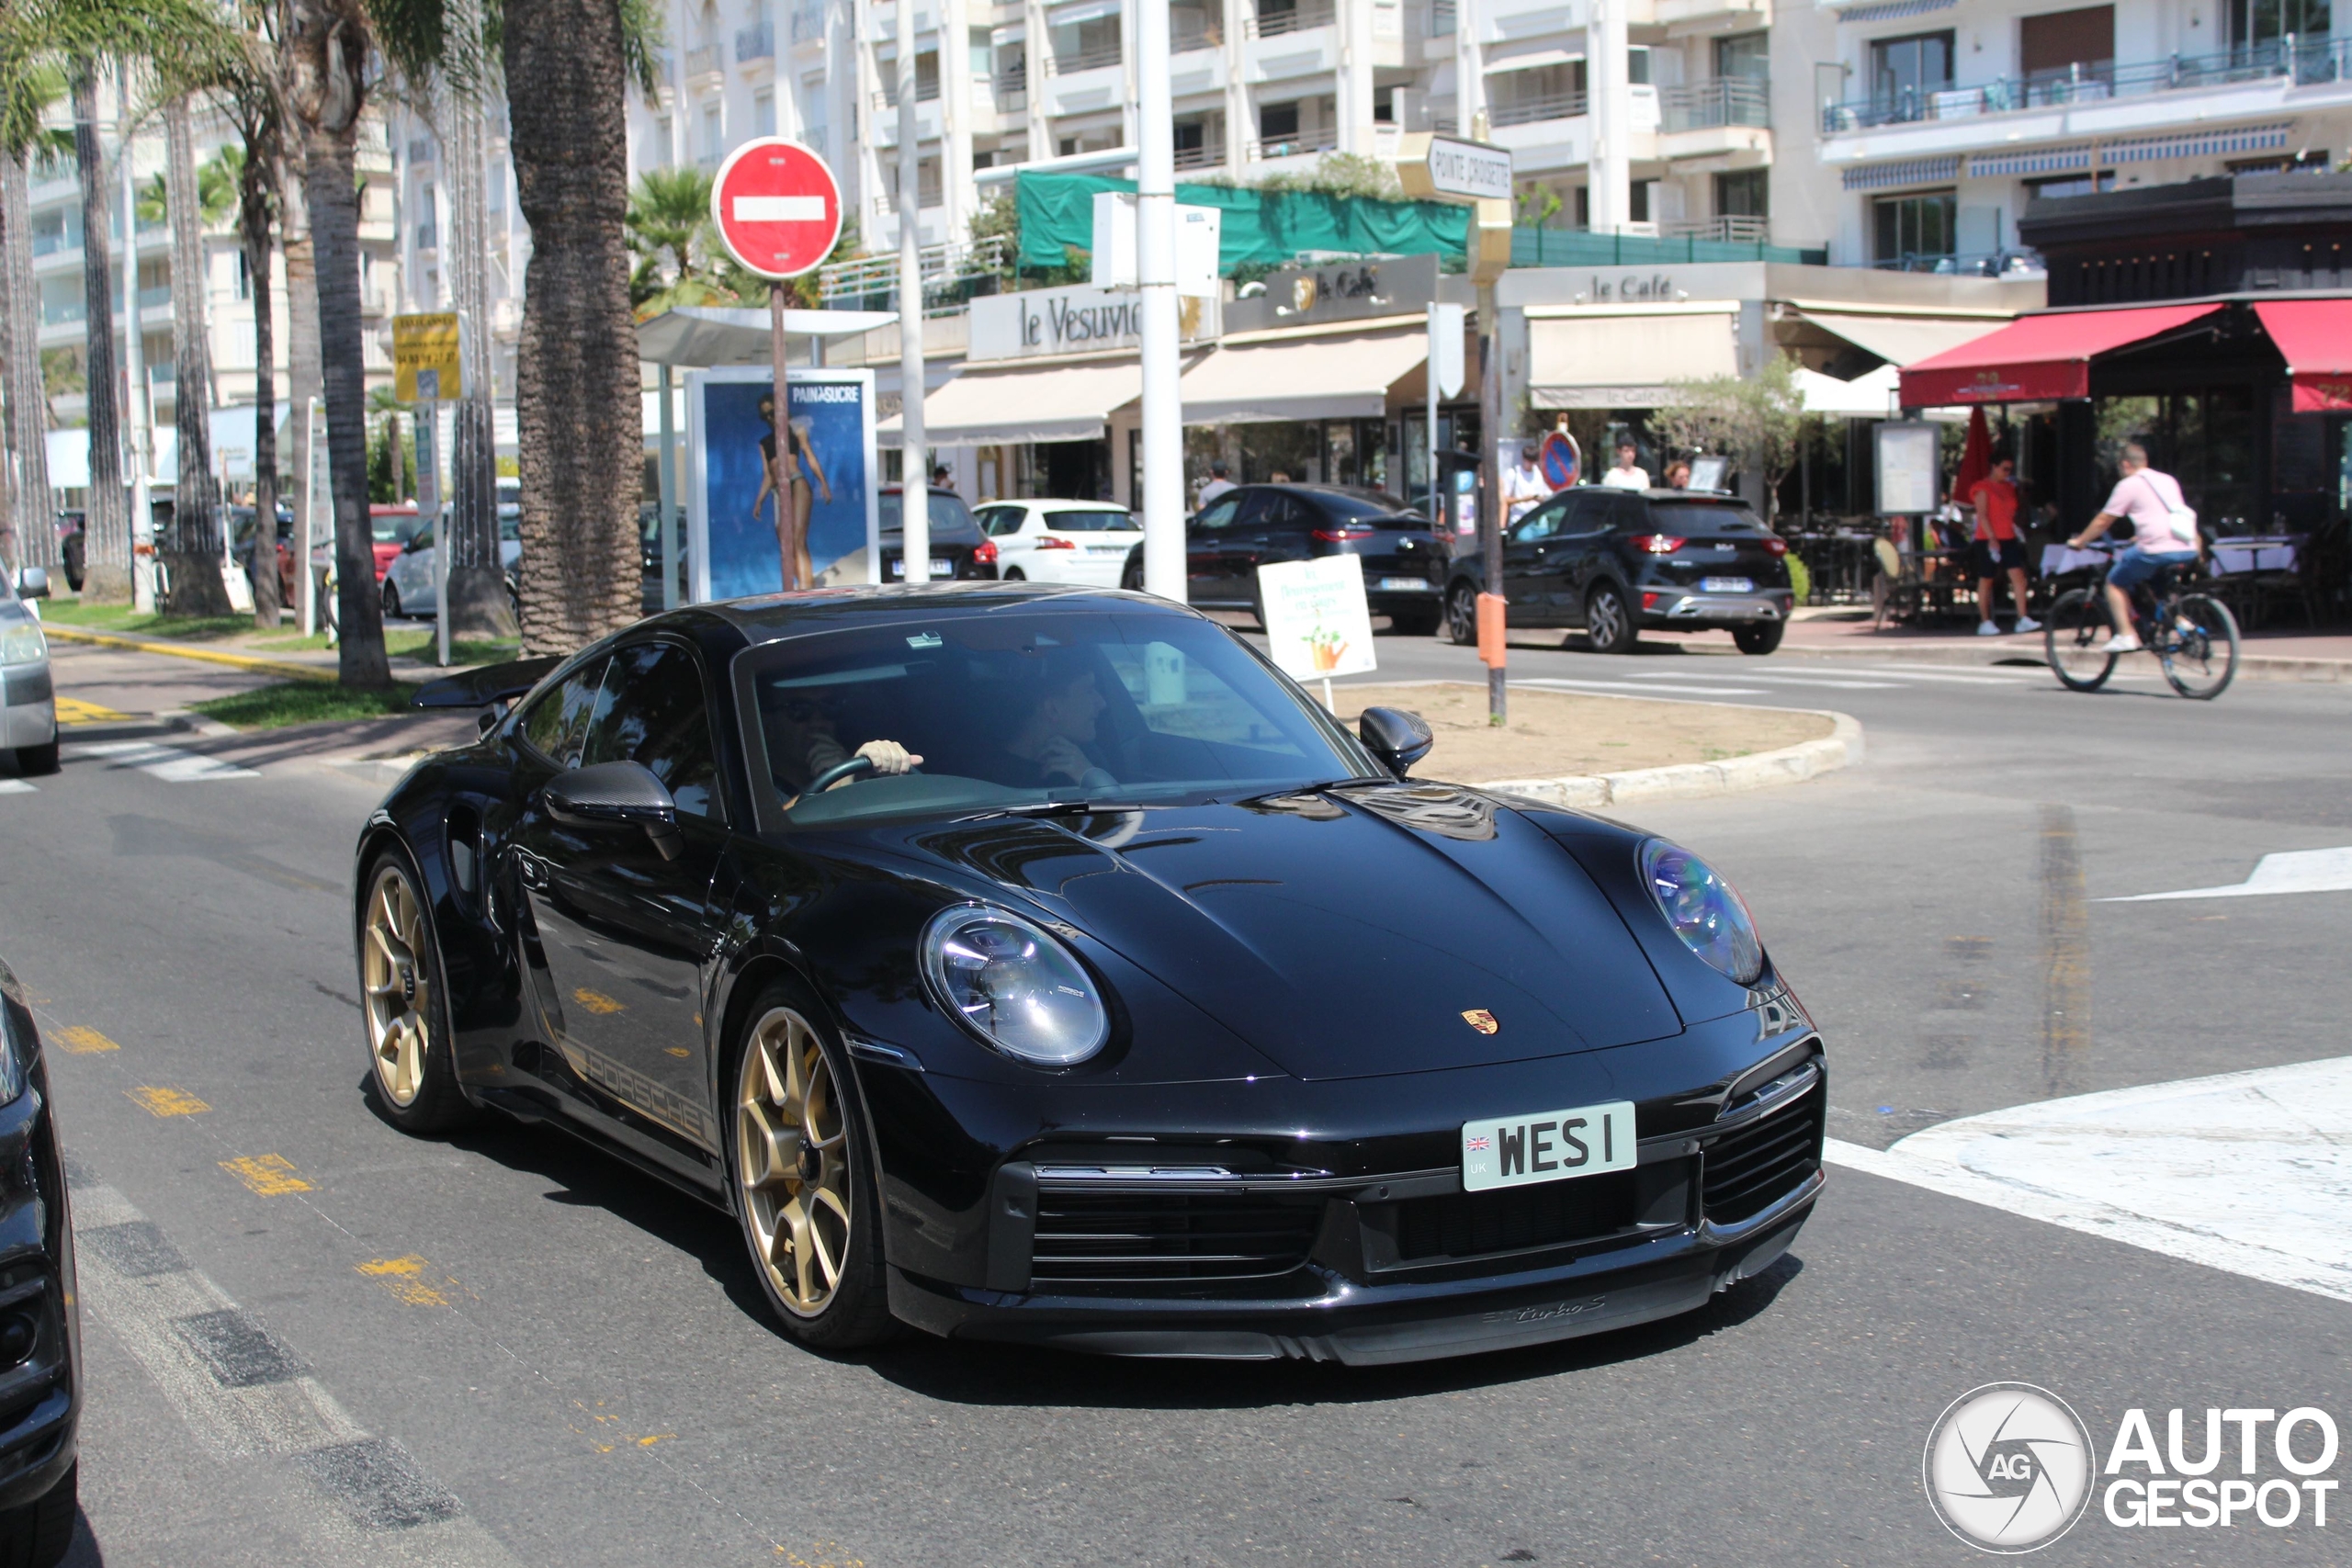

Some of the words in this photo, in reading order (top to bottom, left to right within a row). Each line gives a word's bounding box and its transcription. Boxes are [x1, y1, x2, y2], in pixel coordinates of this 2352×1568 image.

[1435, 150, 1464, 180] POINTE
[1469, 157, 1509, 188] CROISETTE
[1592, 275, 1611, 295] le
[1621, 274, 1672, 295] Café
[1020, 297, 1041, 346] le
[792, 386, 817, 403] PAIN
[824, 385, 859, 404] SUCRE
[589, 1054, 702, 1137] PORSCHE
[1498, 1117, 1589, 1177] WES
[1470, 1162, 1487, 1175] UK
[1583, 1295, 1606, 1312] S
